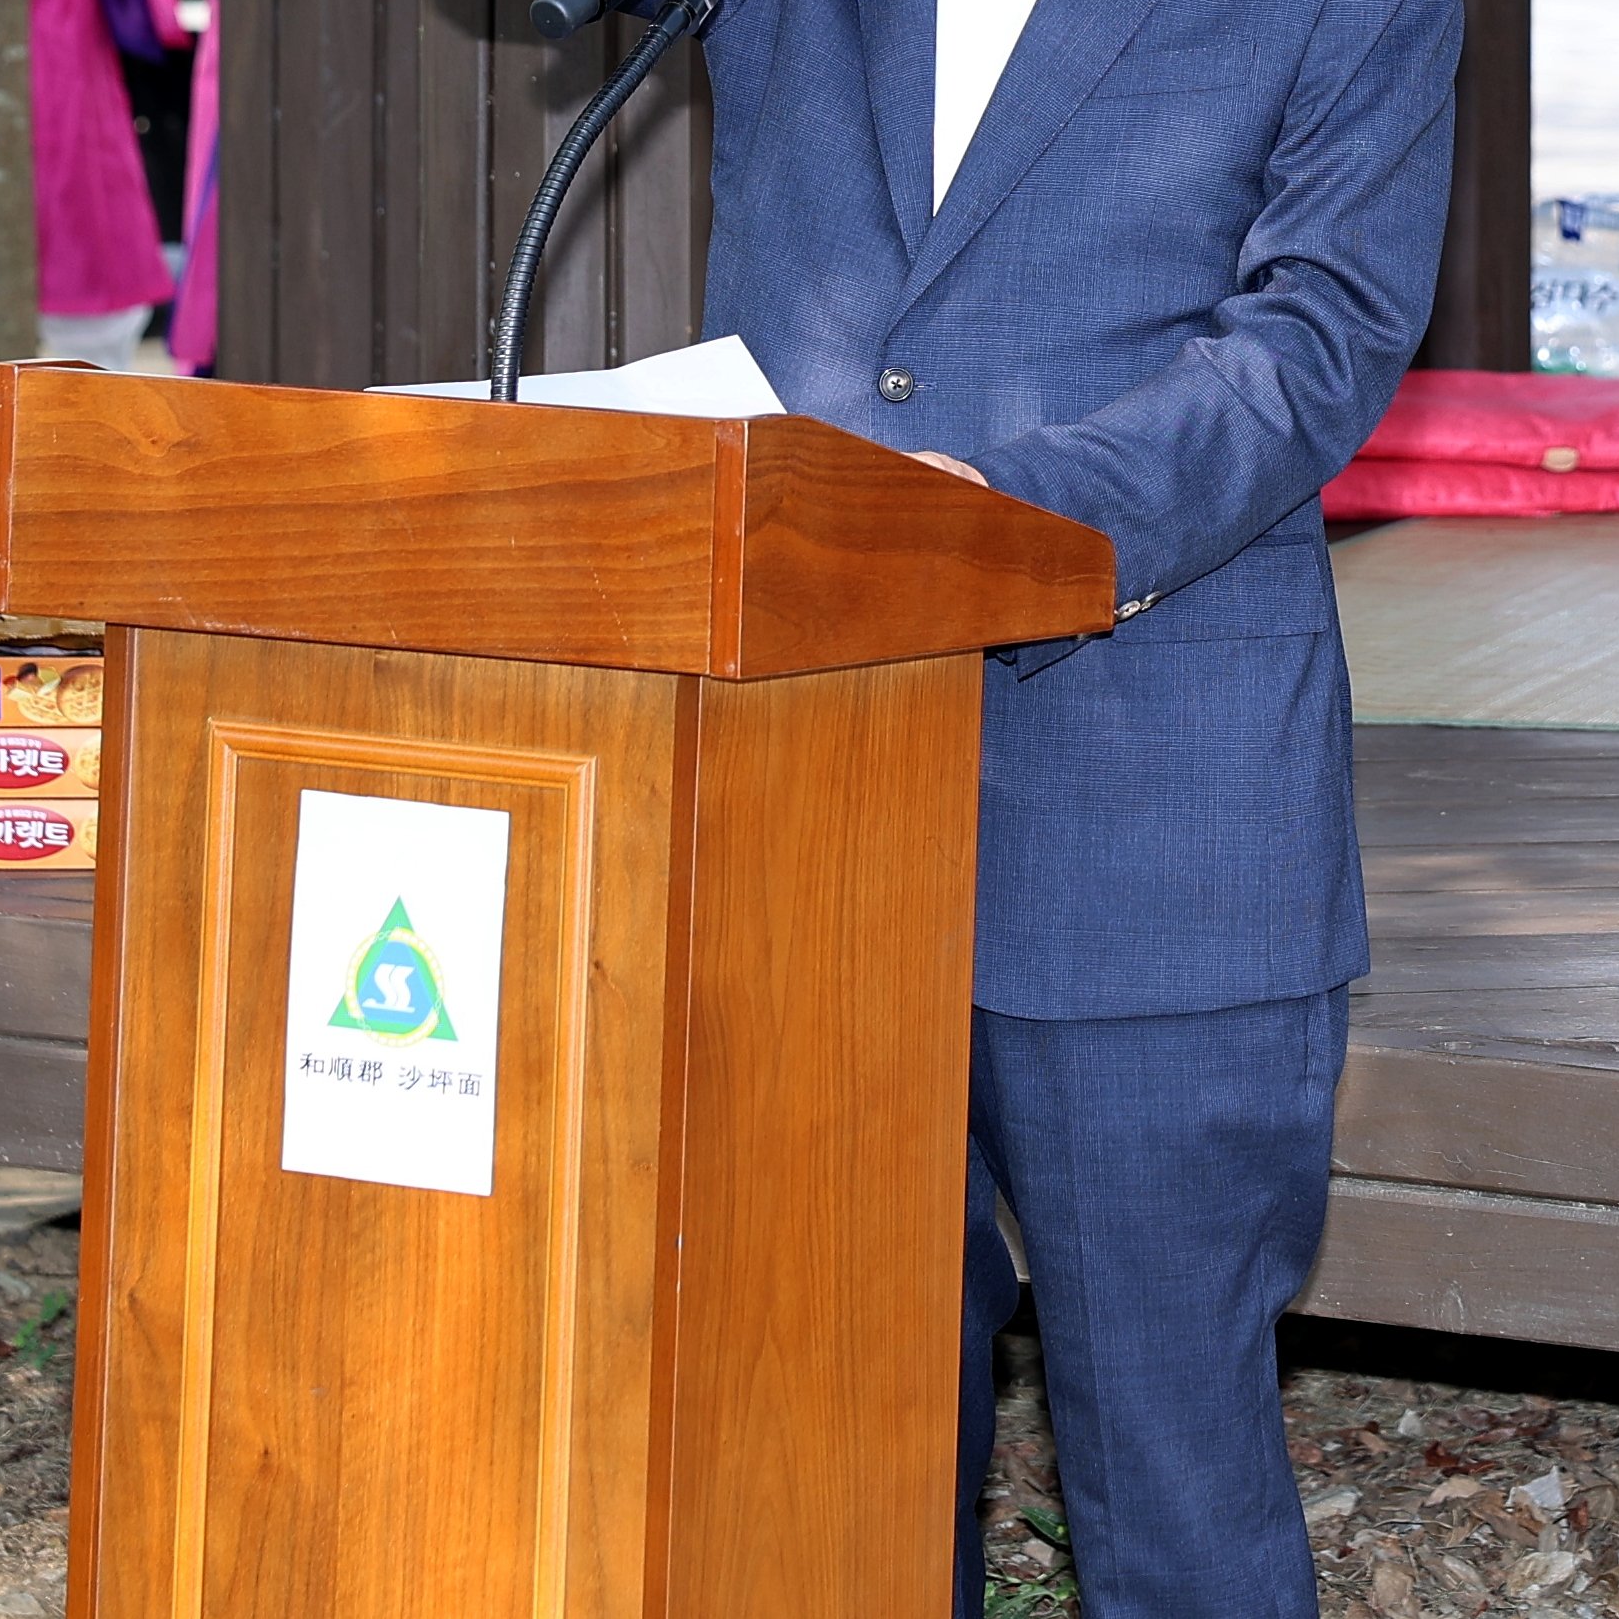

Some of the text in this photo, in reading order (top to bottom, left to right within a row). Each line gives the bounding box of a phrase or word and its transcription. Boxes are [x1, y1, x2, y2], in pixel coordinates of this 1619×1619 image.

[300, 1053, 483, 1097] 和順郡 沙坪面
